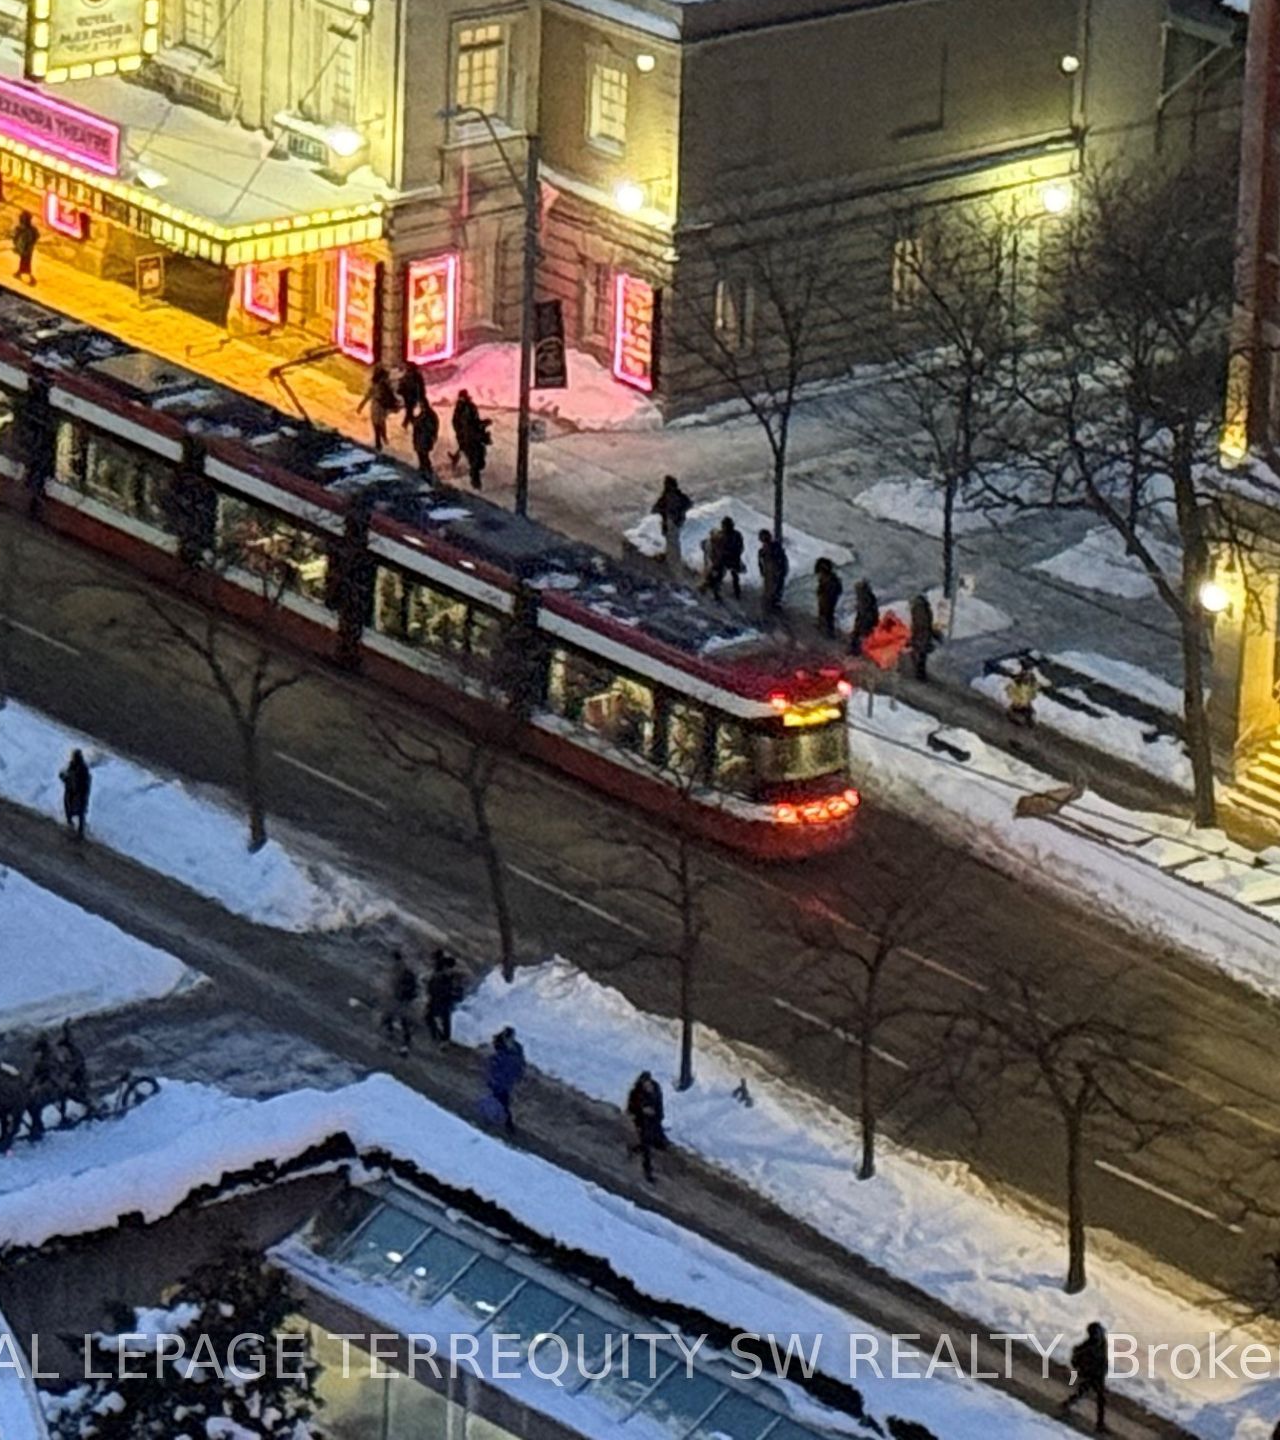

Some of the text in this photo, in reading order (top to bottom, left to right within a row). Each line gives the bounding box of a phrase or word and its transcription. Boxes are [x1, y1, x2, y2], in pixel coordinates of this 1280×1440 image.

[76, 14, 117, 28] ROYAL
[60, 23, 133, 44] ALEXANDRA
[55, 118, 111, 156] THEATRE
